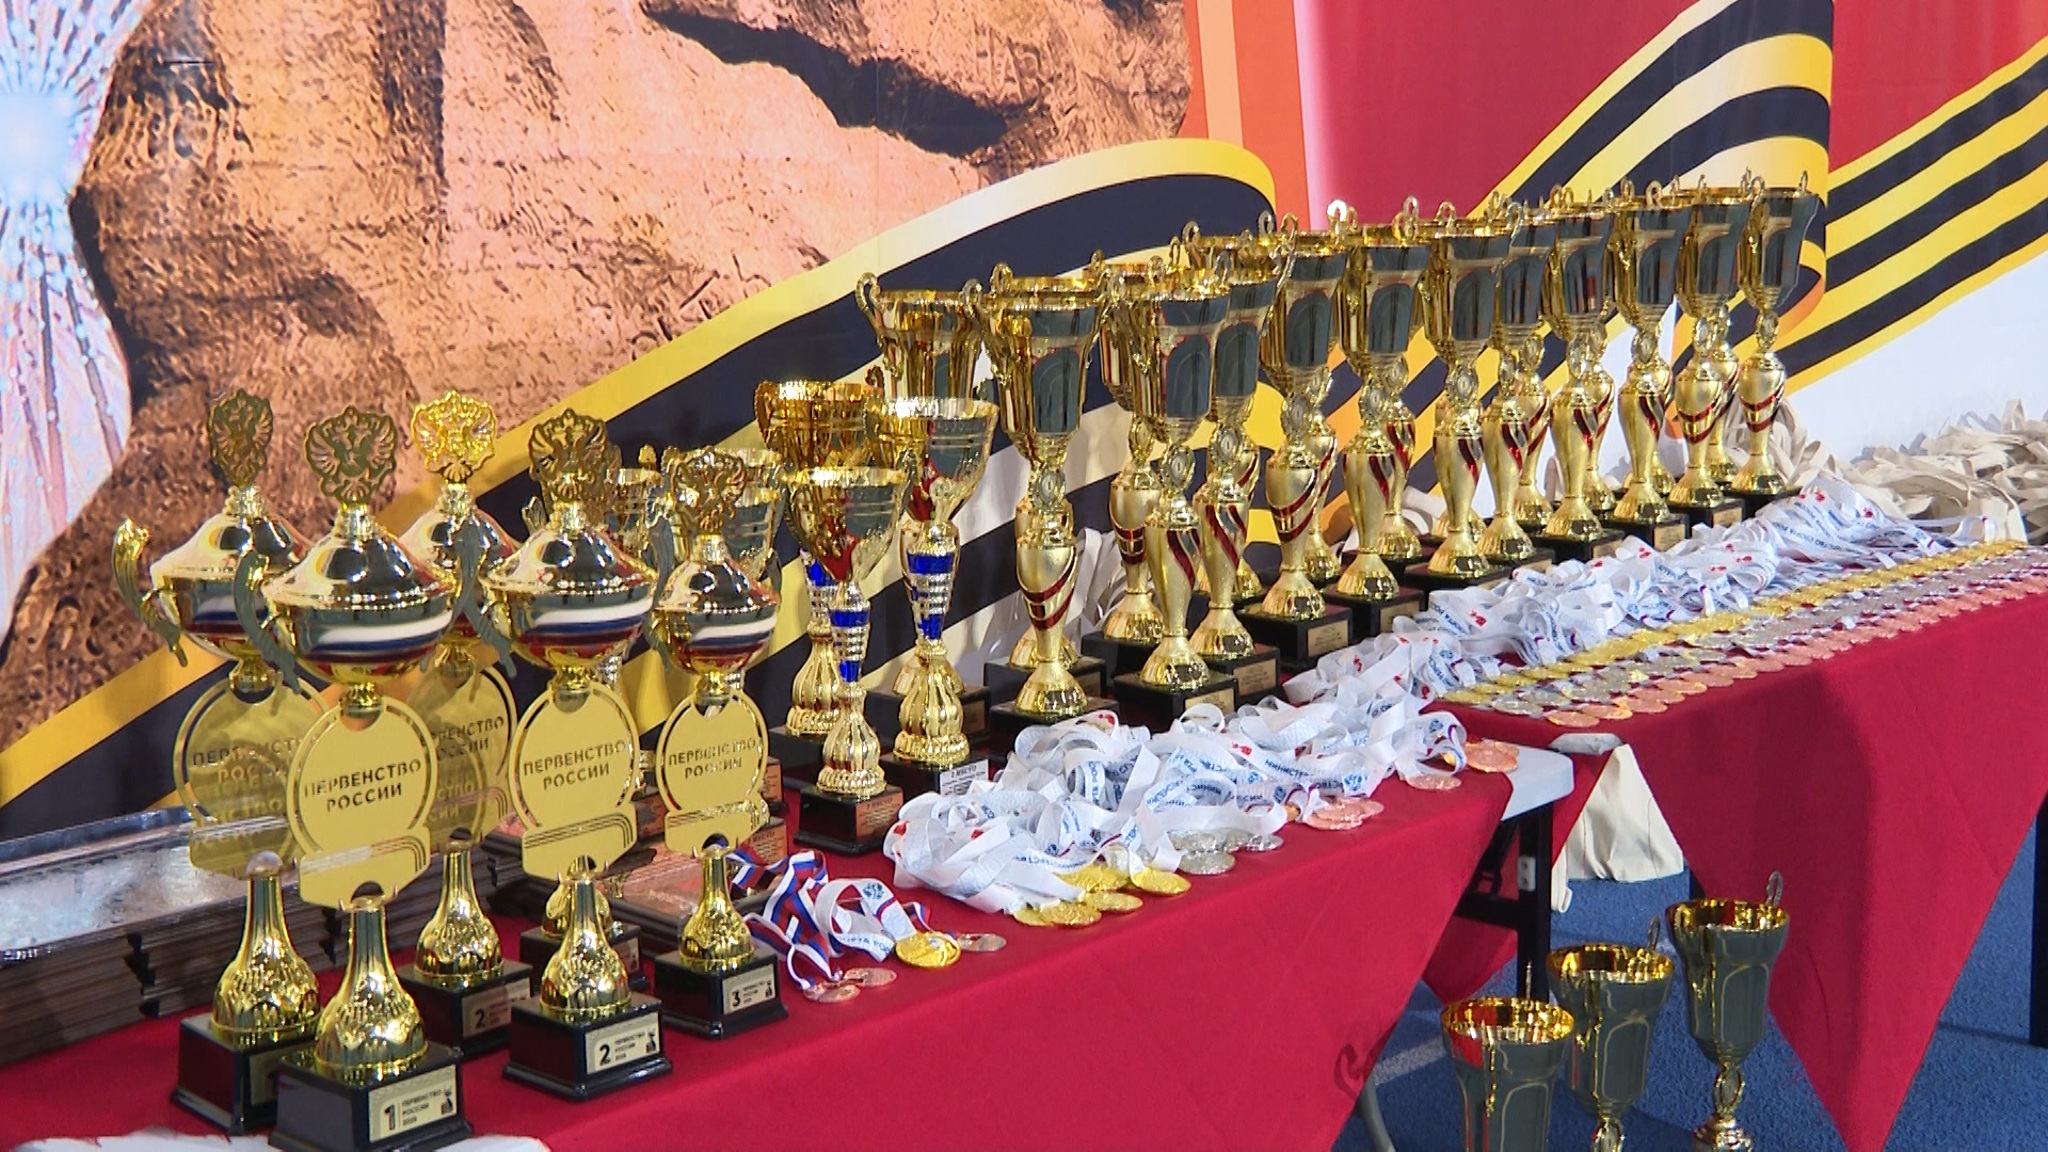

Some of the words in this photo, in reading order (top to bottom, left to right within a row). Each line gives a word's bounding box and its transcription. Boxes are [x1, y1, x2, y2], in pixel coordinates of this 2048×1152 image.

[523, 739, 626, 777] ПЕРВЕНСТВО
[668, 738, 756, 767] ПЕРВЕНСТВО
[304, 759, 421, 798] ПЕРВЕНСТВО
[543, 763, 609, 791] РОССИИ
[327, 783, 402, 813] РОССИИ
[731, 989, 741, 1007] 3
[474, 1008, 486, 1030] 2
[599, 1044, 611, 1066] 2
[384, 1104, 396, 1131] 1
